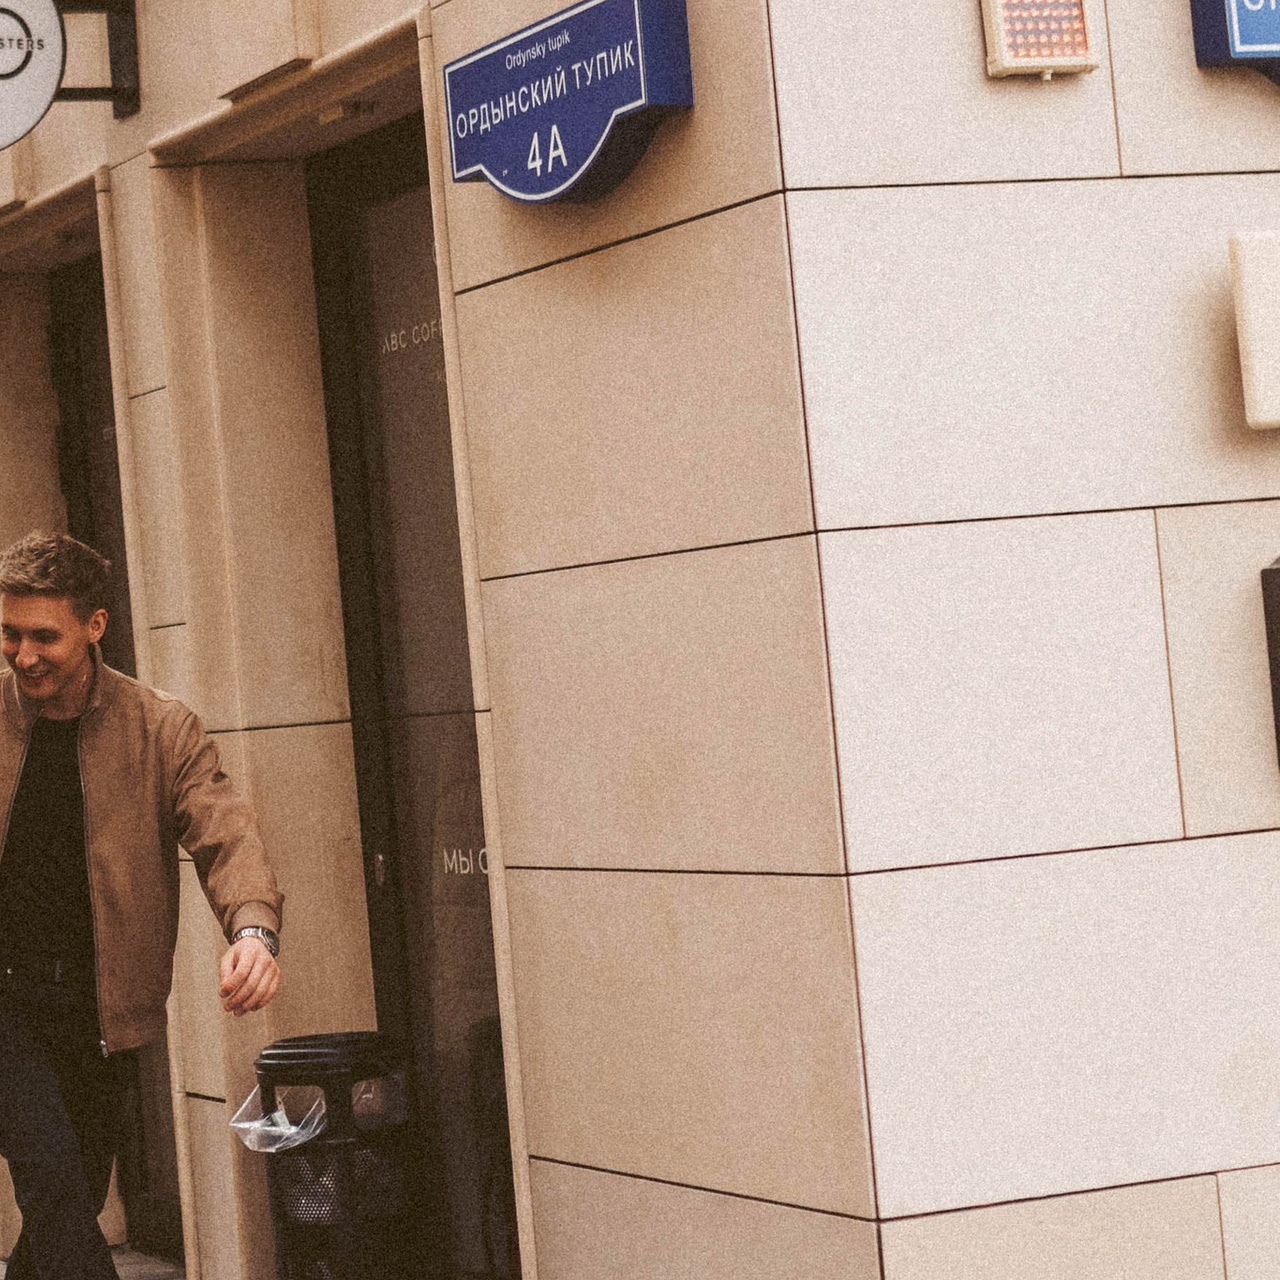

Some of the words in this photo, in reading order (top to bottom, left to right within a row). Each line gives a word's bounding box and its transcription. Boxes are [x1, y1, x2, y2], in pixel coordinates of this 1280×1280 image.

[505, 40, 546, 70] Ordynsky
[548, 29, 570, 52] tupik
[456, 66, 567, 138] ОРДЫНСКИЙ
[571, 40, 635, 90] ТУПИК
[526, 124, 568, 177] 4А
[382, 330, 407, 354] ABC
[443, 848, 474, 874] МЫ
